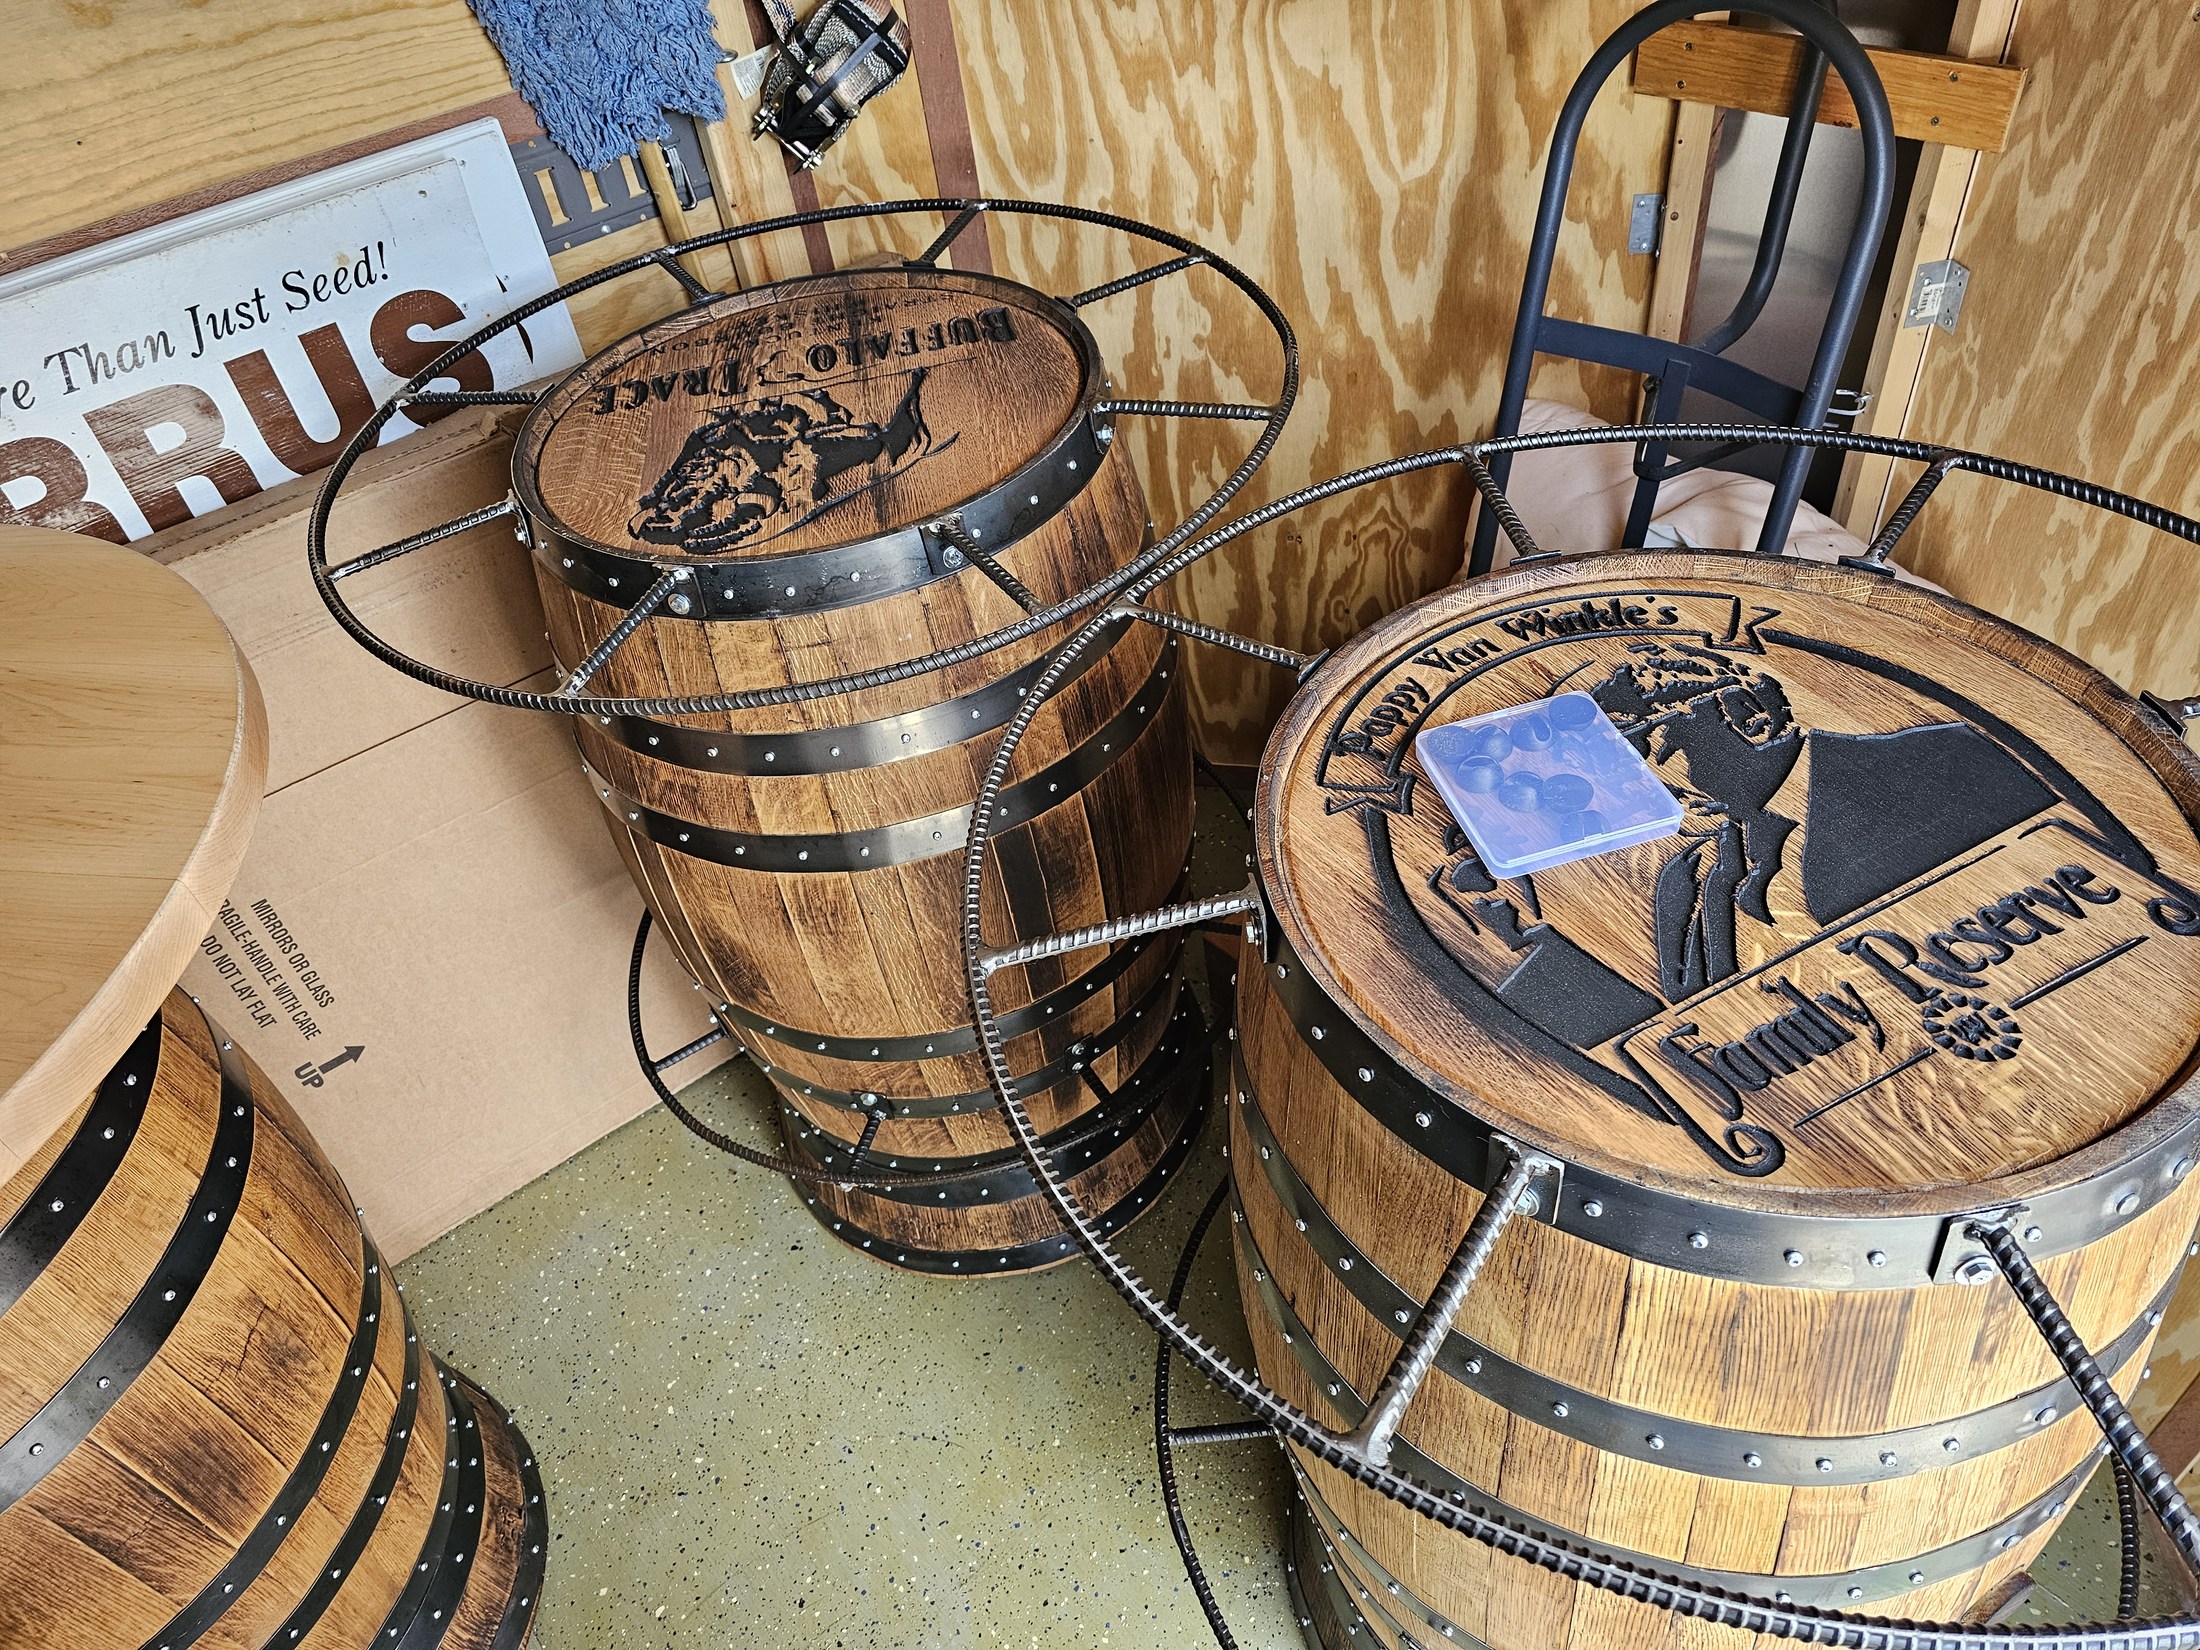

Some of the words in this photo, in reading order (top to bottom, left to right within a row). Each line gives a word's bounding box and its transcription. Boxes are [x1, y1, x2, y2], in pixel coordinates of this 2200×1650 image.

[44, 331, 176, 396] Than
[185, 288, 270, 358] Just
[282, 241, 389, 314] Seed!
[806, 306, 1018, 373] BUFFALO
[594, 359, 749, 415] TRACE
[1336, 676, 1430, 762] Pappy
[1411, 637, 1502, 673] Van
[1495, 595, 1679, 641] Winkle's
[201, 934, 223, 956] DO
[212, 953, 243, 980] NOT
[230, 977, 258, 1002] LAY
[246, 999, 278, 1029] FLAT
[217, 898, 283, 985] RAGILE-HANDLE
[272, 981, 302, 1014] WITH
[291, 1000, 322, 1041] CARE
[251, 898, 298, 954] MIRRORS
[288, 952, 310, 973] OR
[300, 970, 335, 1008] GLASS
[1659, 975, 1886, 1121] Family
[1836, 864, 2121, 1004] Reserve
[294, 1061, 325, 1088] UP
